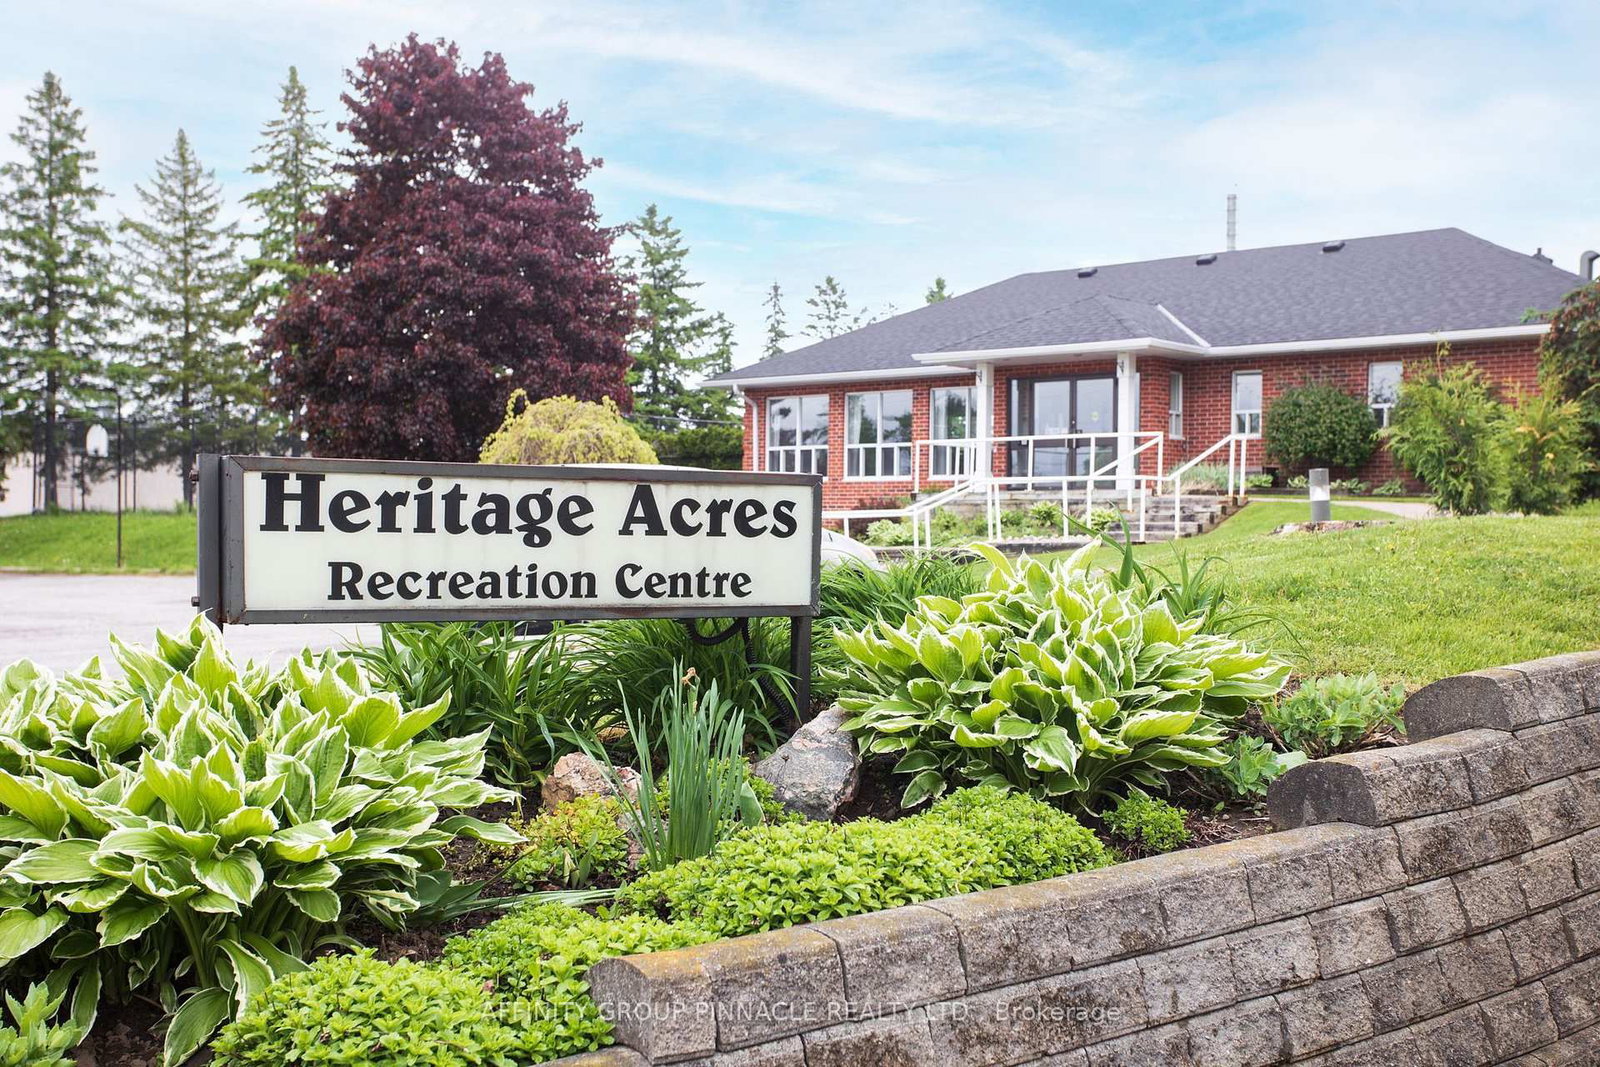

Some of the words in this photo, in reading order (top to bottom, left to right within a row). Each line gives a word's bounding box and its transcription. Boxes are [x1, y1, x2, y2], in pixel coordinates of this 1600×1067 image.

[260, 472, 593, 548] Heritage
[618, 483, 798, 538] Acres
[327, 561, 597, 600] Recreation
[615, 563, 752, 599] Centre
